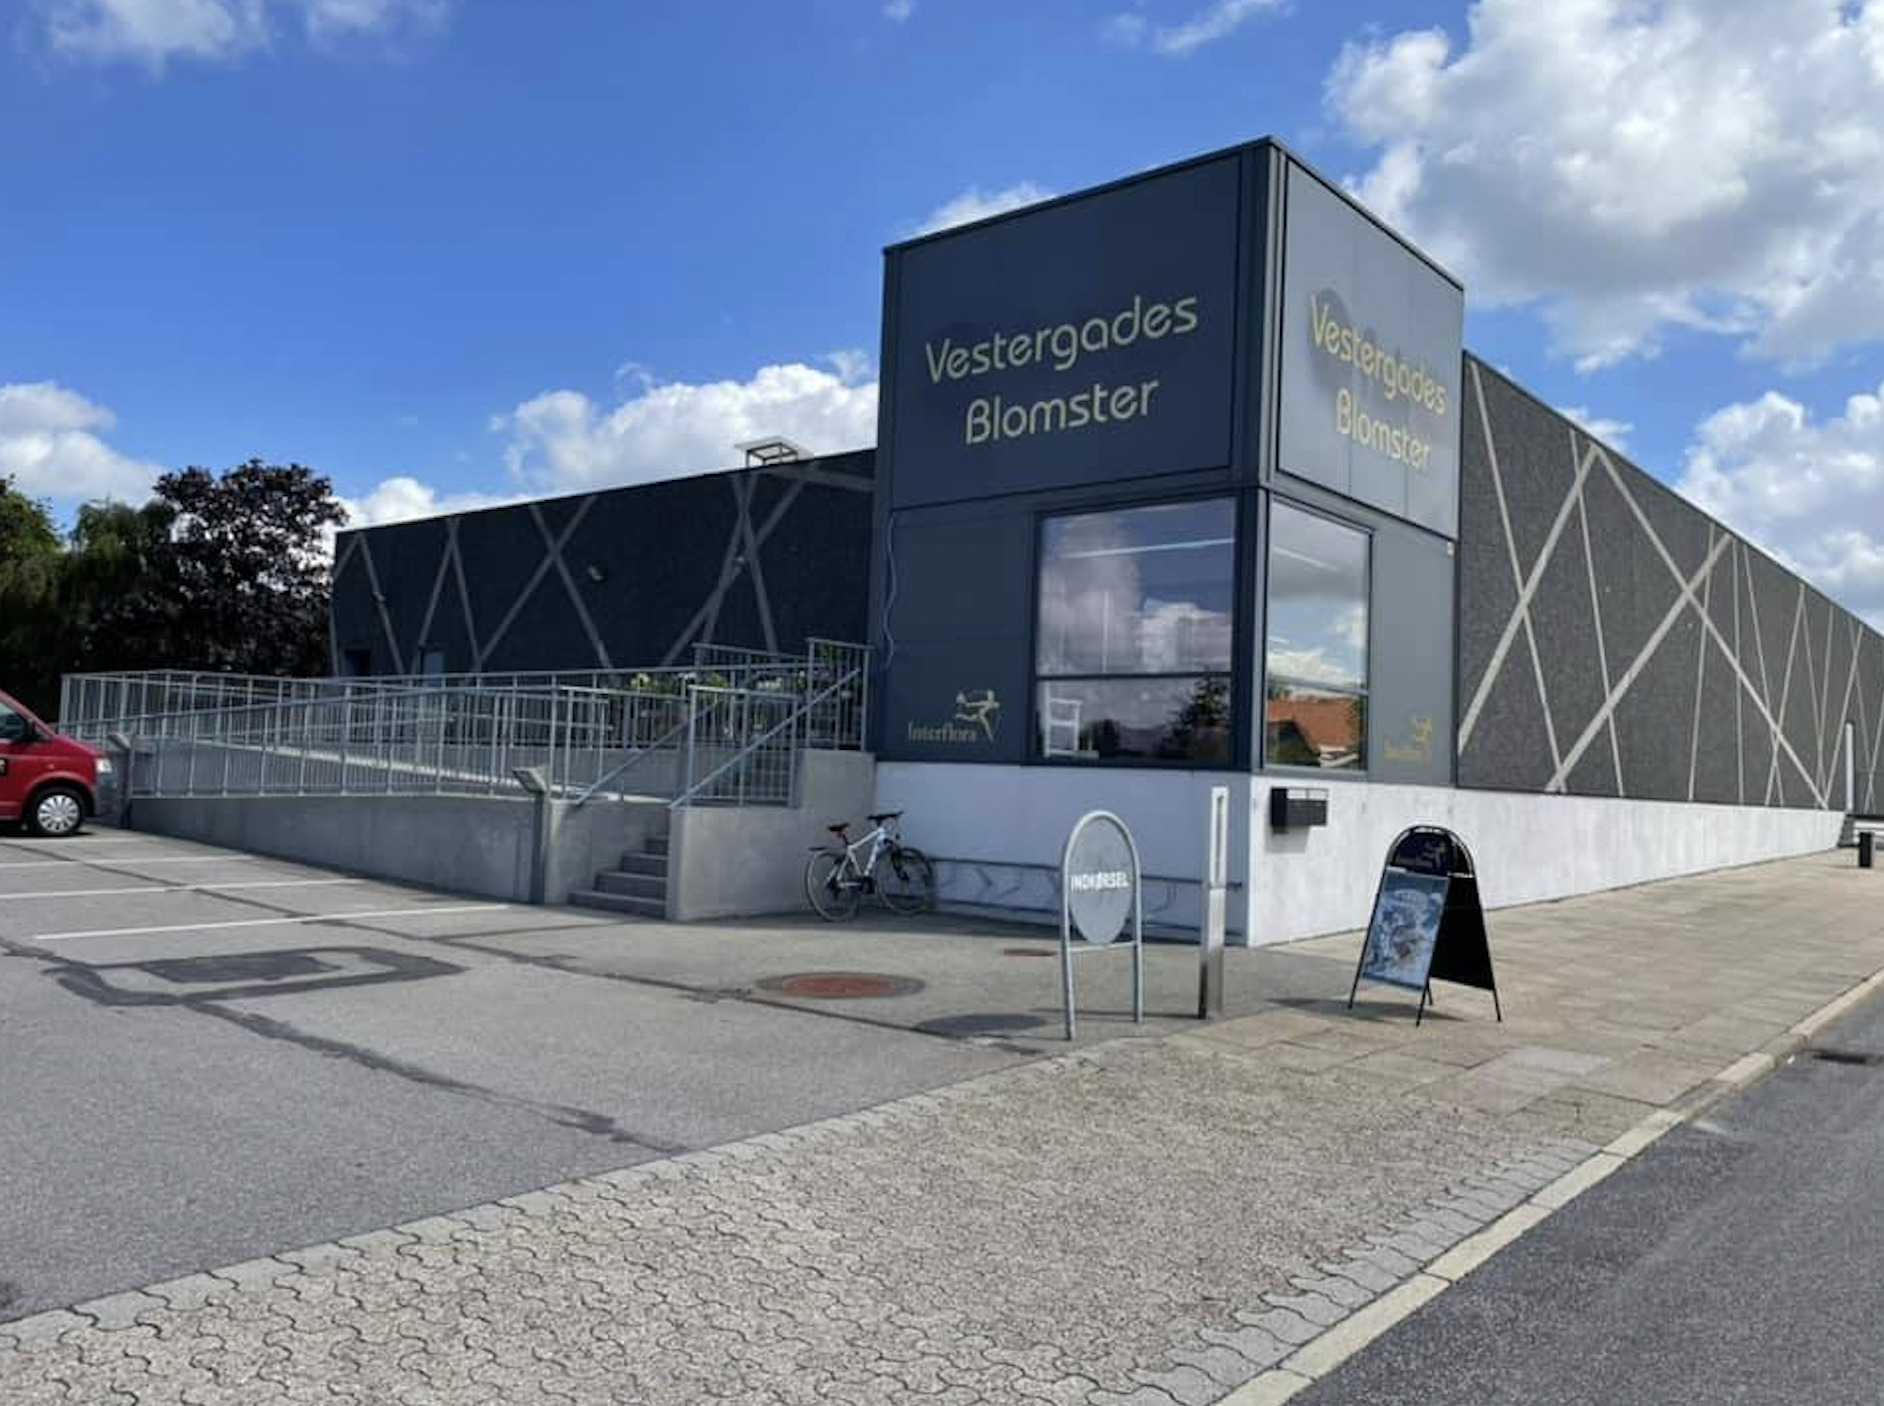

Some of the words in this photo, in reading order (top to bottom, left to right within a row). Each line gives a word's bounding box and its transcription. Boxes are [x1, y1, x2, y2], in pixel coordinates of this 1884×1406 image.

[926, 294, 1198, 383] Vestergades
[1310, 292, 1448, 414] Vestergades
[965, 379, 1159, 445] Blomster
[1336, 387, 1430, 469] Blomster
